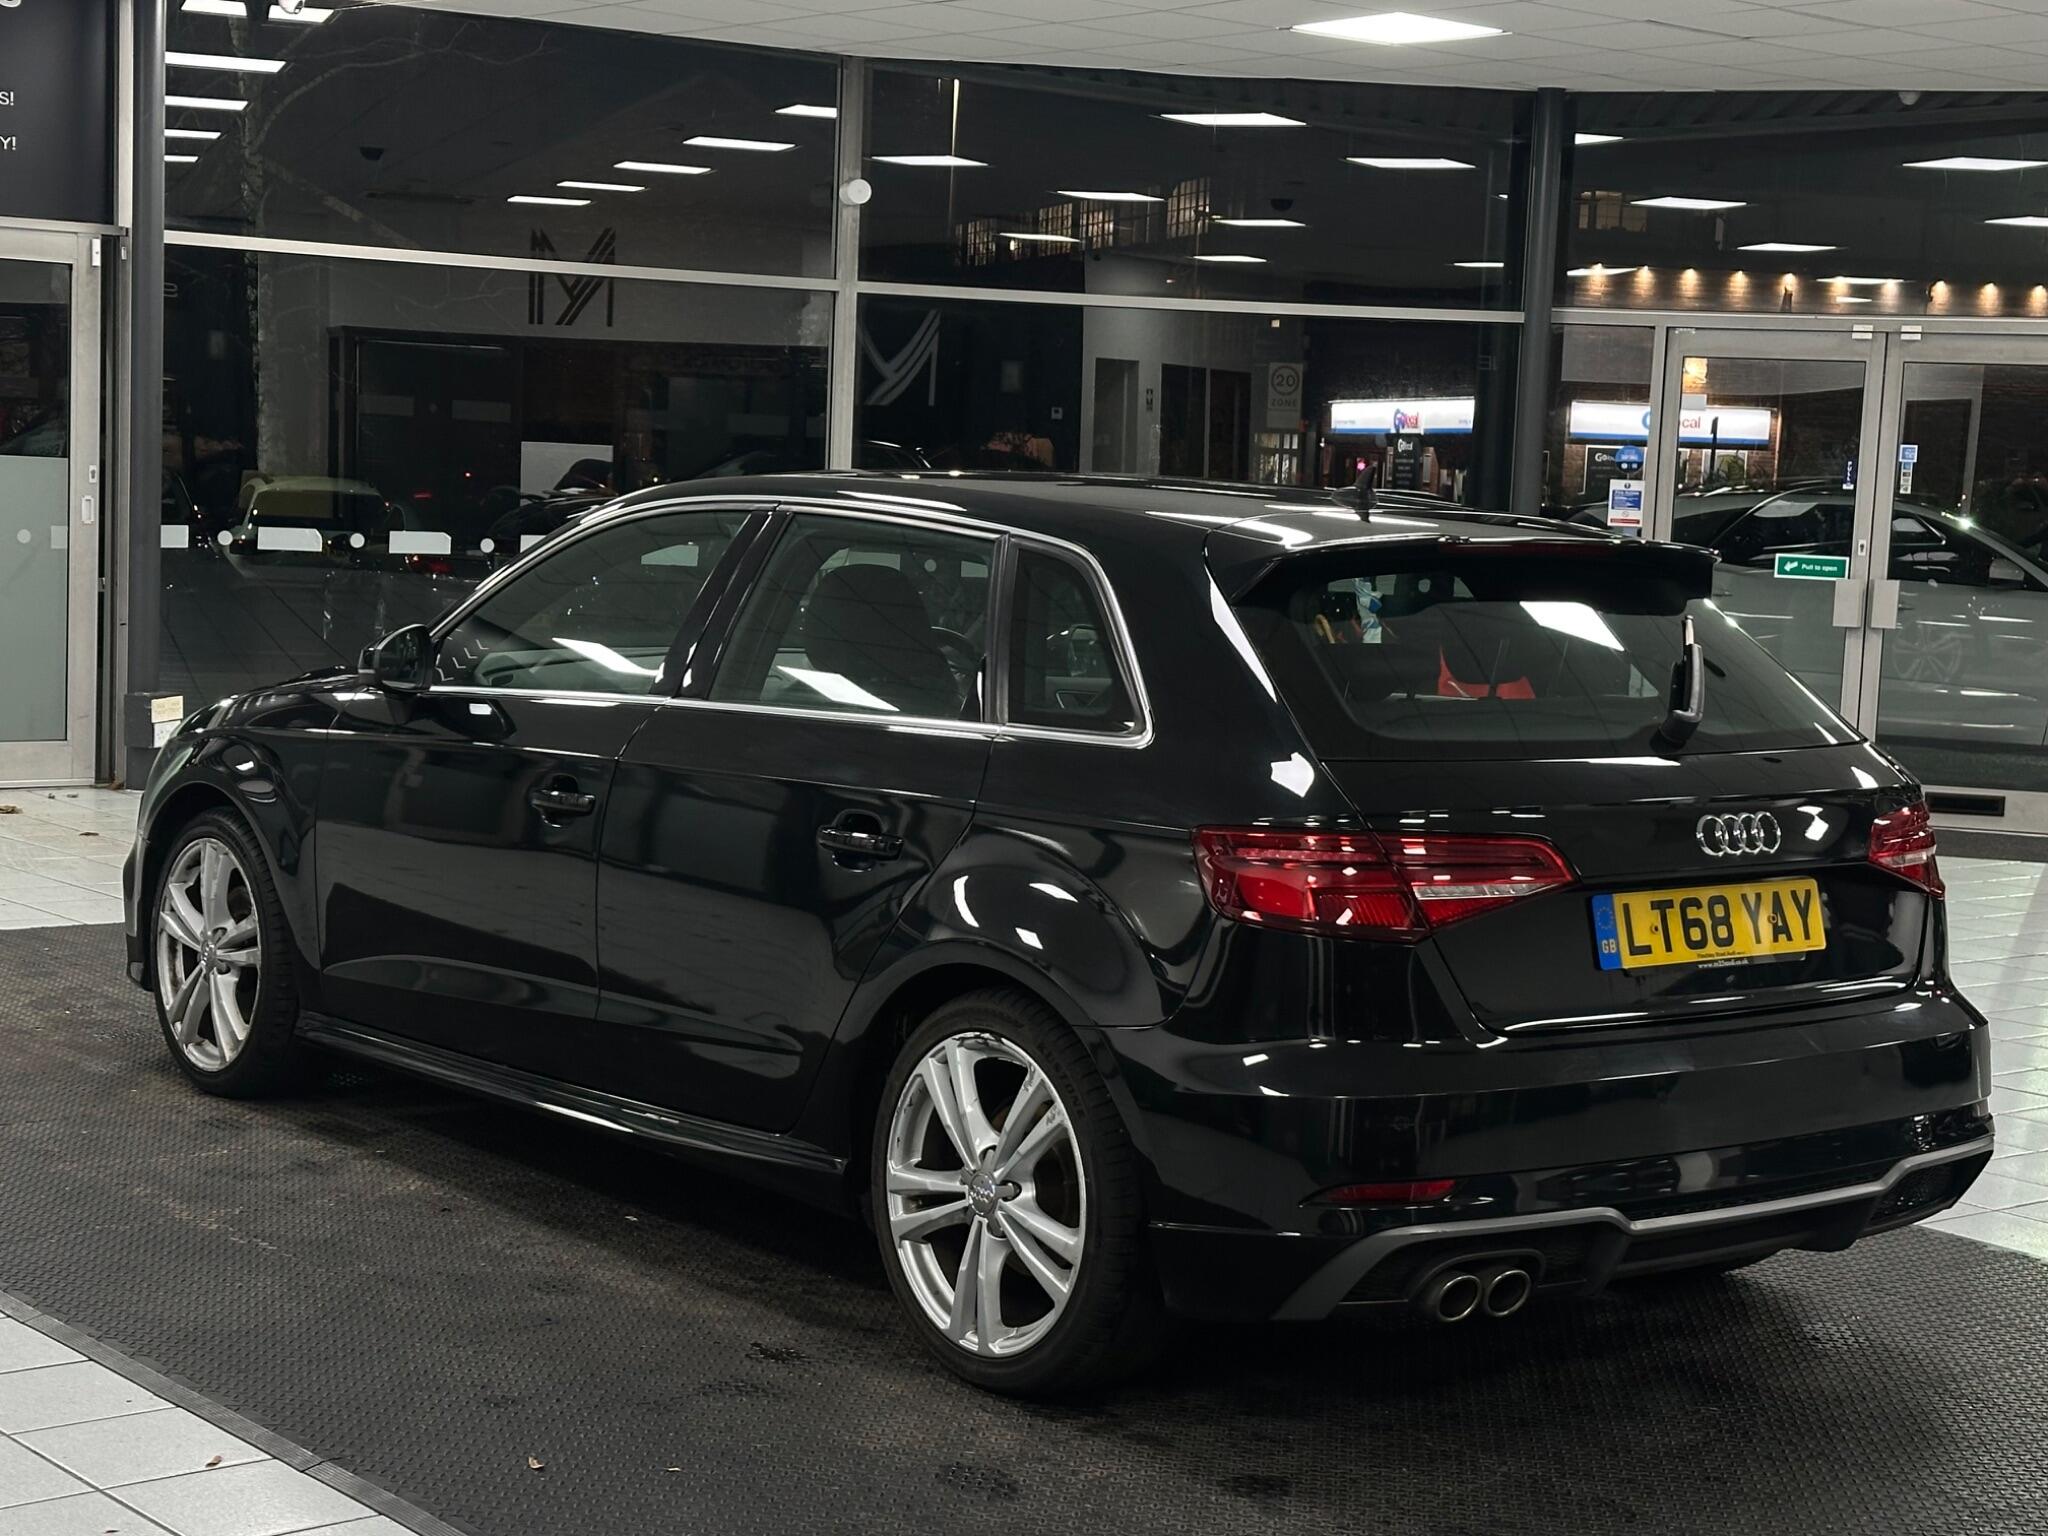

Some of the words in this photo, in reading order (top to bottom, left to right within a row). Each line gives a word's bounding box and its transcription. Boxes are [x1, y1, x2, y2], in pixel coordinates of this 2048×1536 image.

[1276, 374, 1296, 387] 20
[1271, 398, 1297, 407] ZONE
[1801, 563, 1814, 571] Pull
[1622, 894, 1735, 956] LT68
[1740, 889, 1812, 945] YAY
[1601, 939, 1617, 954] GB
